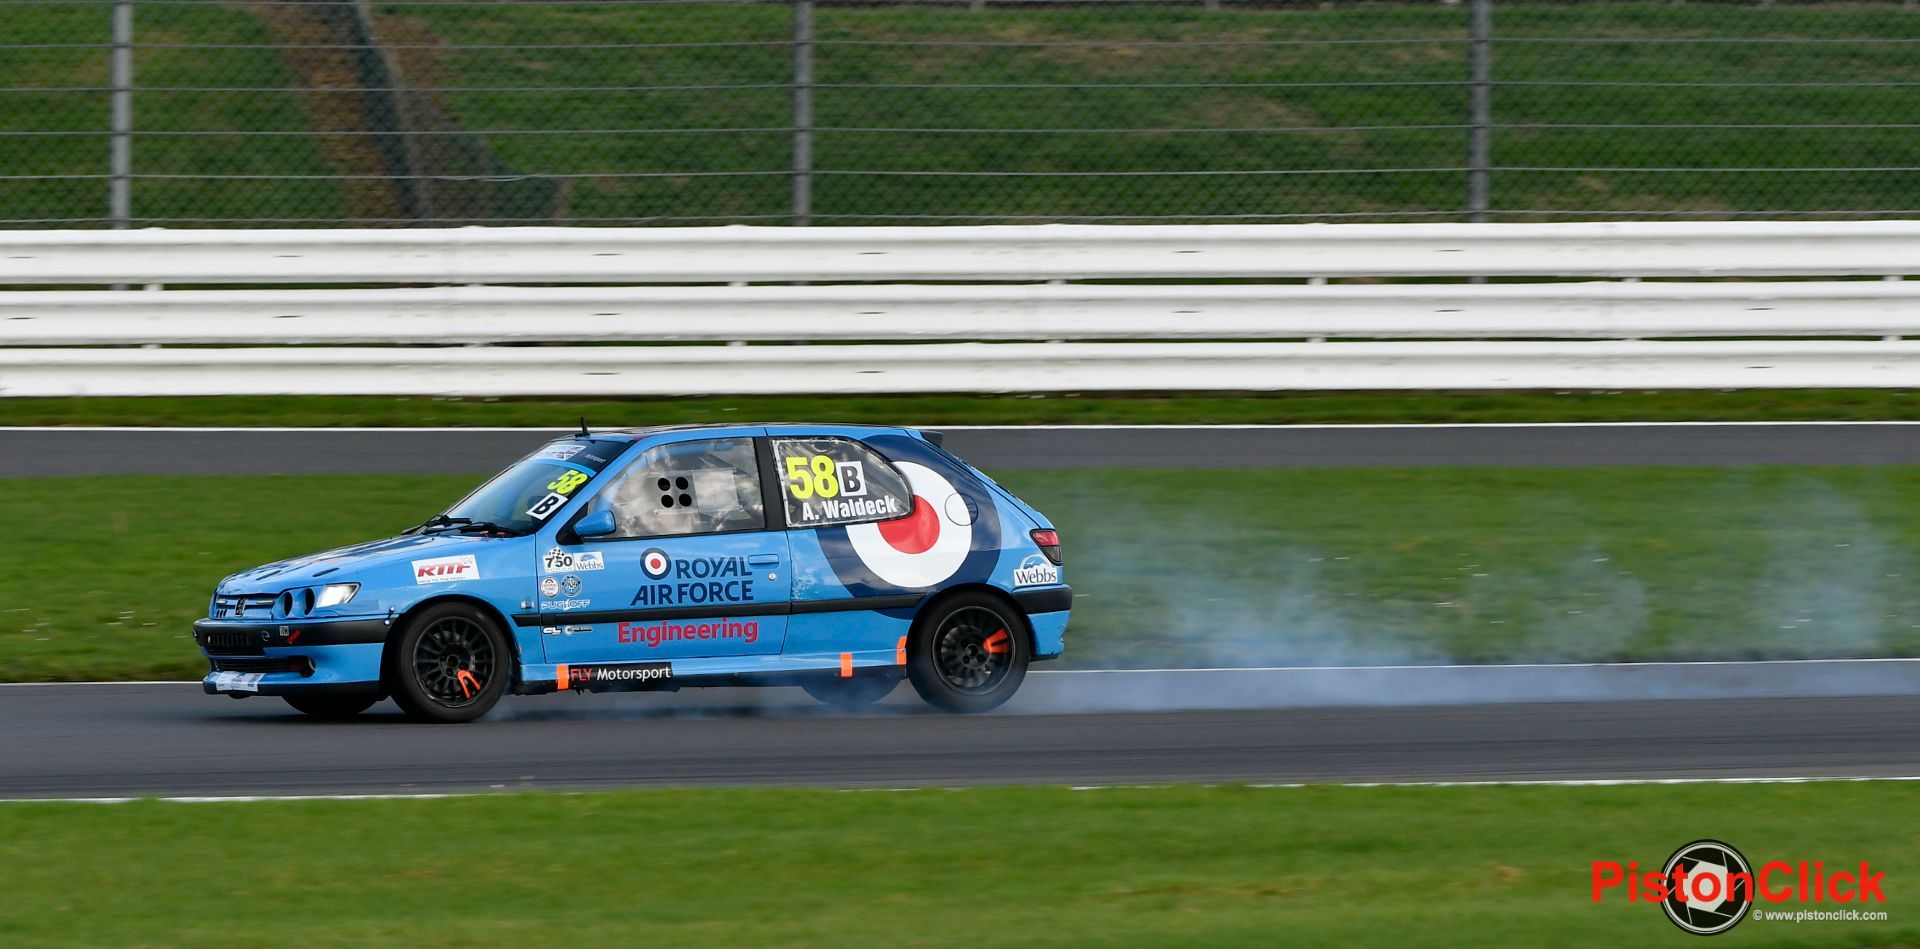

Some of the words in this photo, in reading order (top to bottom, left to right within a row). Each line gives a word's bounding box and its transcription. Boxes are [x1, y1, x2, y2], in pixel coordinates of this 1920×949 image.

[547, 469, 588, 494] 58
[786, 455, 839, 499] 58
[842, 465, 861, 493] B
[533, 495, 559, 515] B
[802, 502, 820, 521] A.
[822, 496, 898, 519] Waldeck
[545, 555, 573, 568] 750
[576, 561, 604, 570] Webbs
[676, 556, 753, 579] ROYAL
[1016, 567, 1057, 584] Webbs
[630, 583, 673, 606] AIR
[677, 580, 754, 604] FORCE
[618, 617, 758, 647] Engineering
[596, 665, 672, 682] Motorsport
